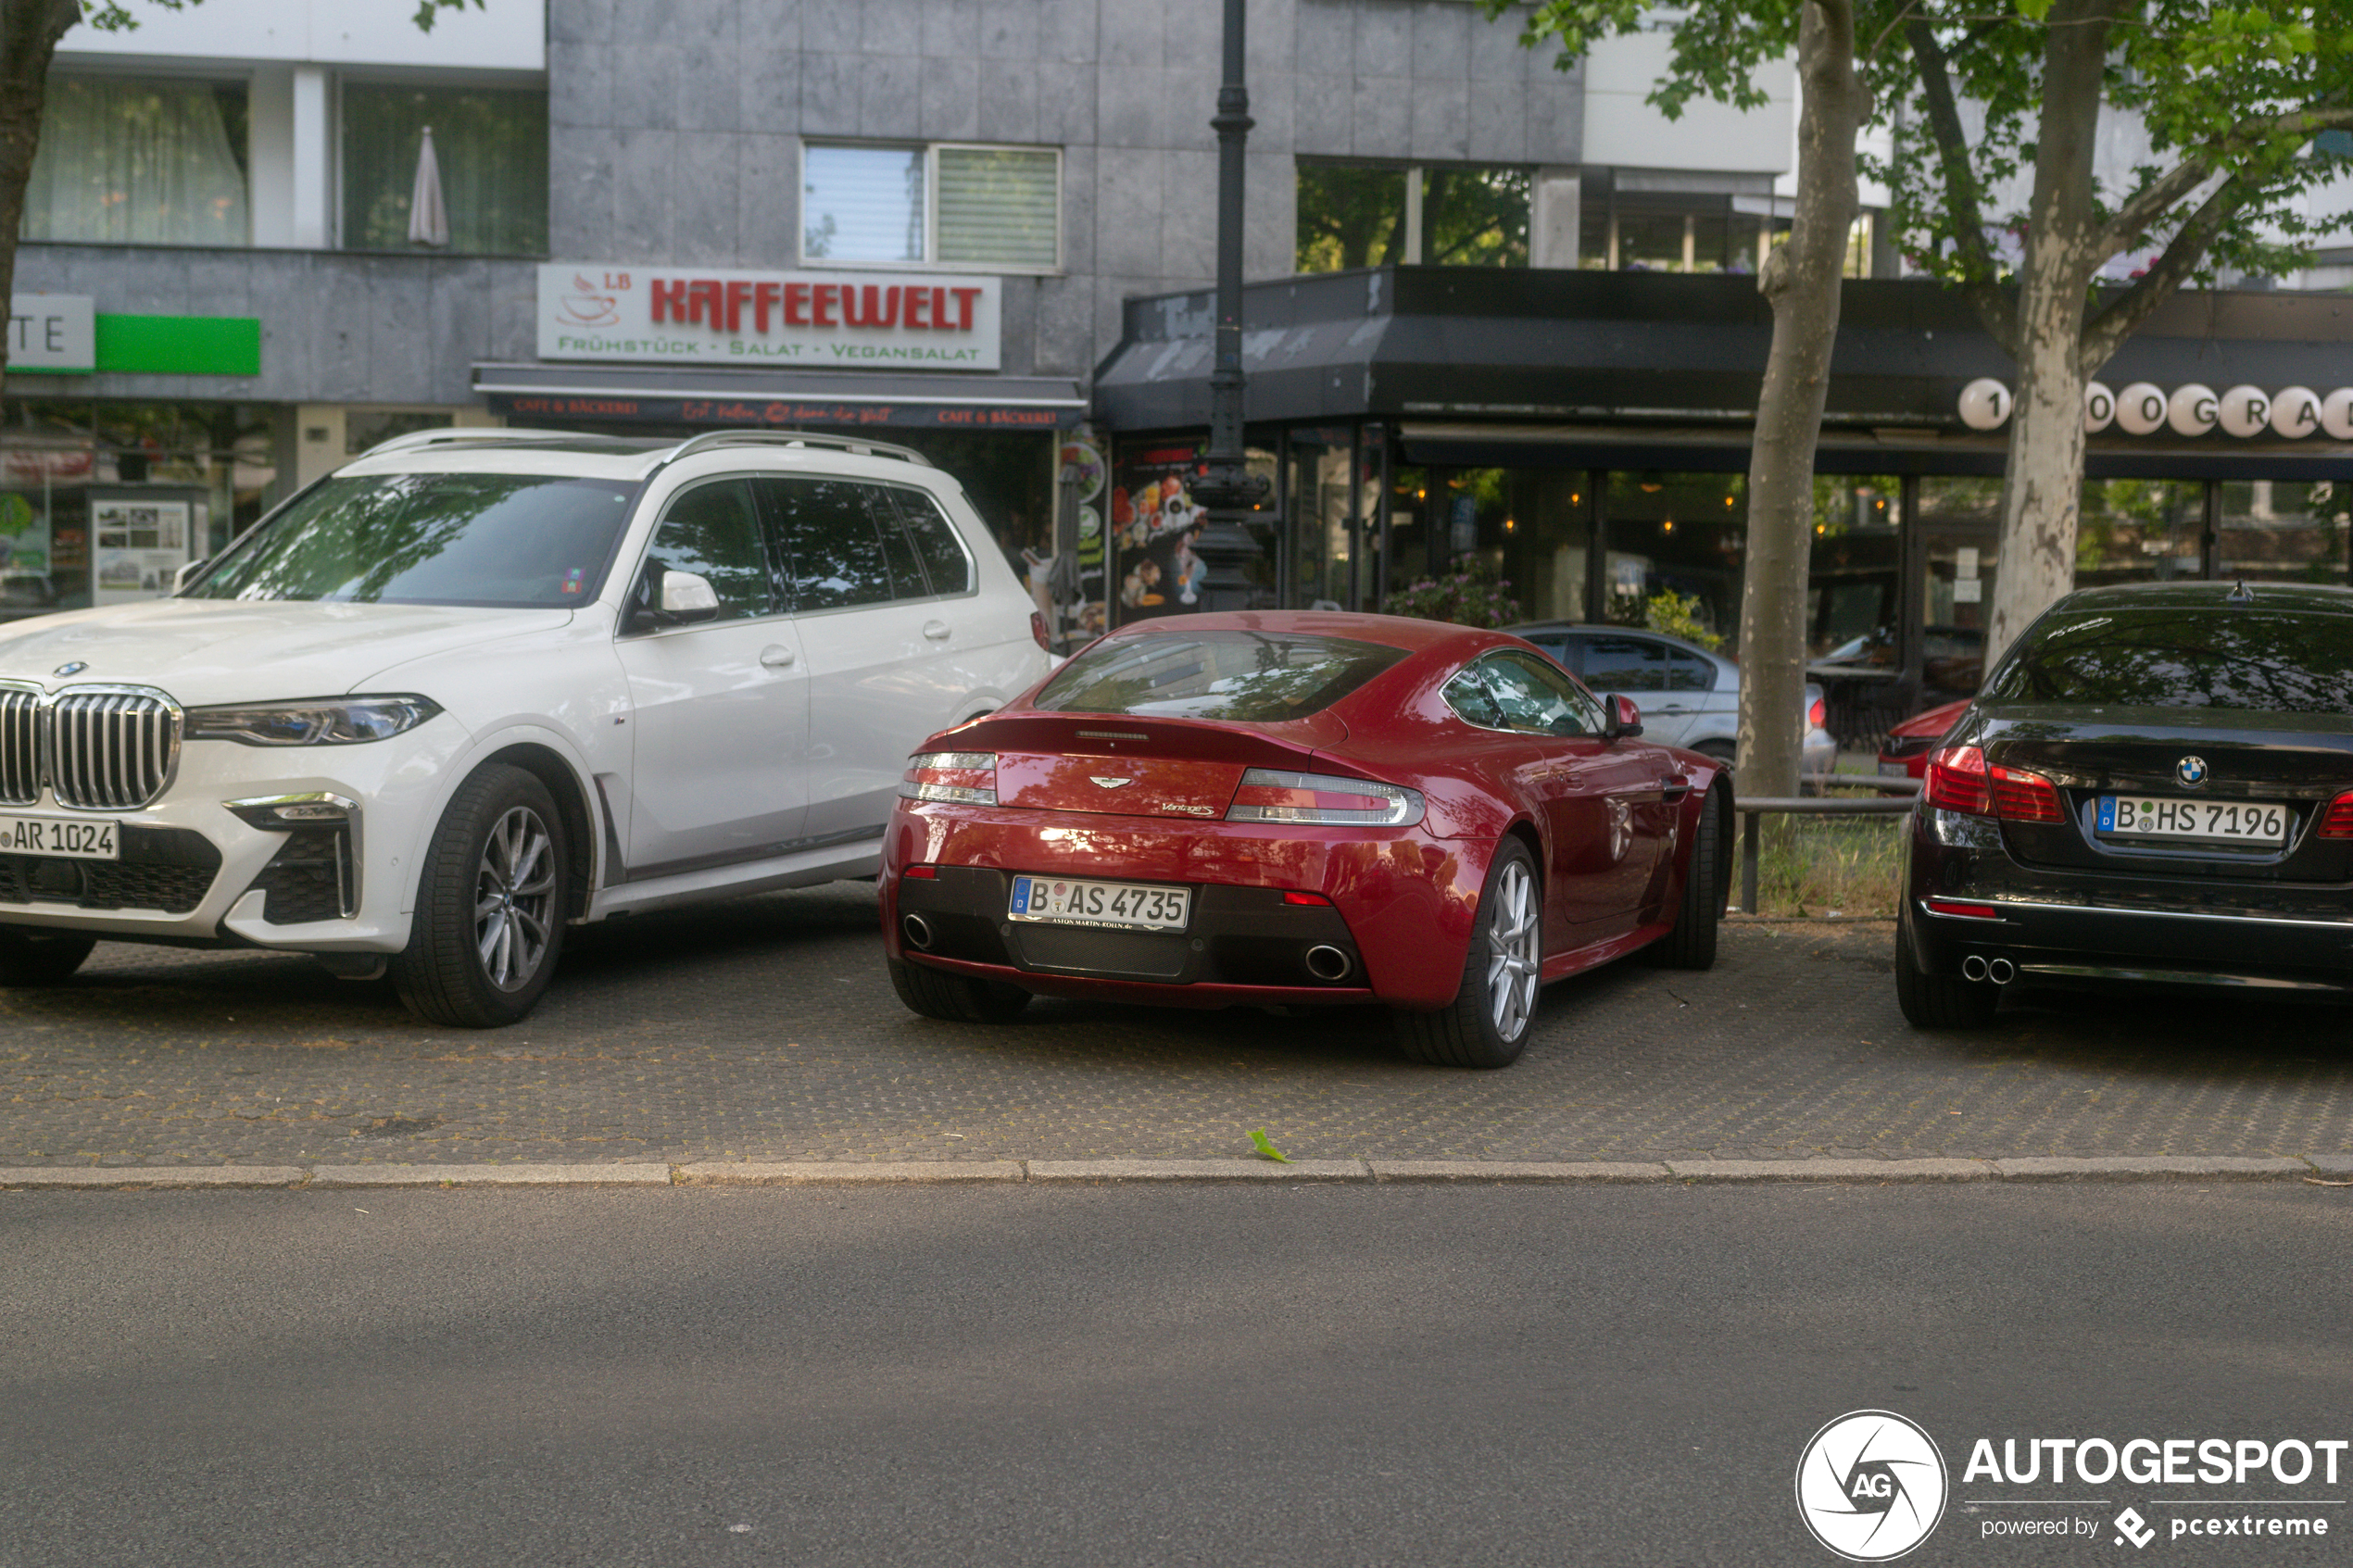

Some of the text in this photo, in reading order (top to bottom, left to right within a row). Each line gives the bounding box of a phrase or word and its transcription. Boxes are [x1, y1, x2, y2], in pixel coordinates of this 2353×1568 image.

[604, 274, 631, 291] LB
[651, 279, 982, 332] KAFFEEWELT
[558, 335, 979, 361] FRÜHSTÜCK SALAT VEGANSALAT
[2117, 800, 2281, 835] B HS 7196
[14, 821, 113, 853] AR 1024
[1029, 883, 1184, 922] B AS 4735
